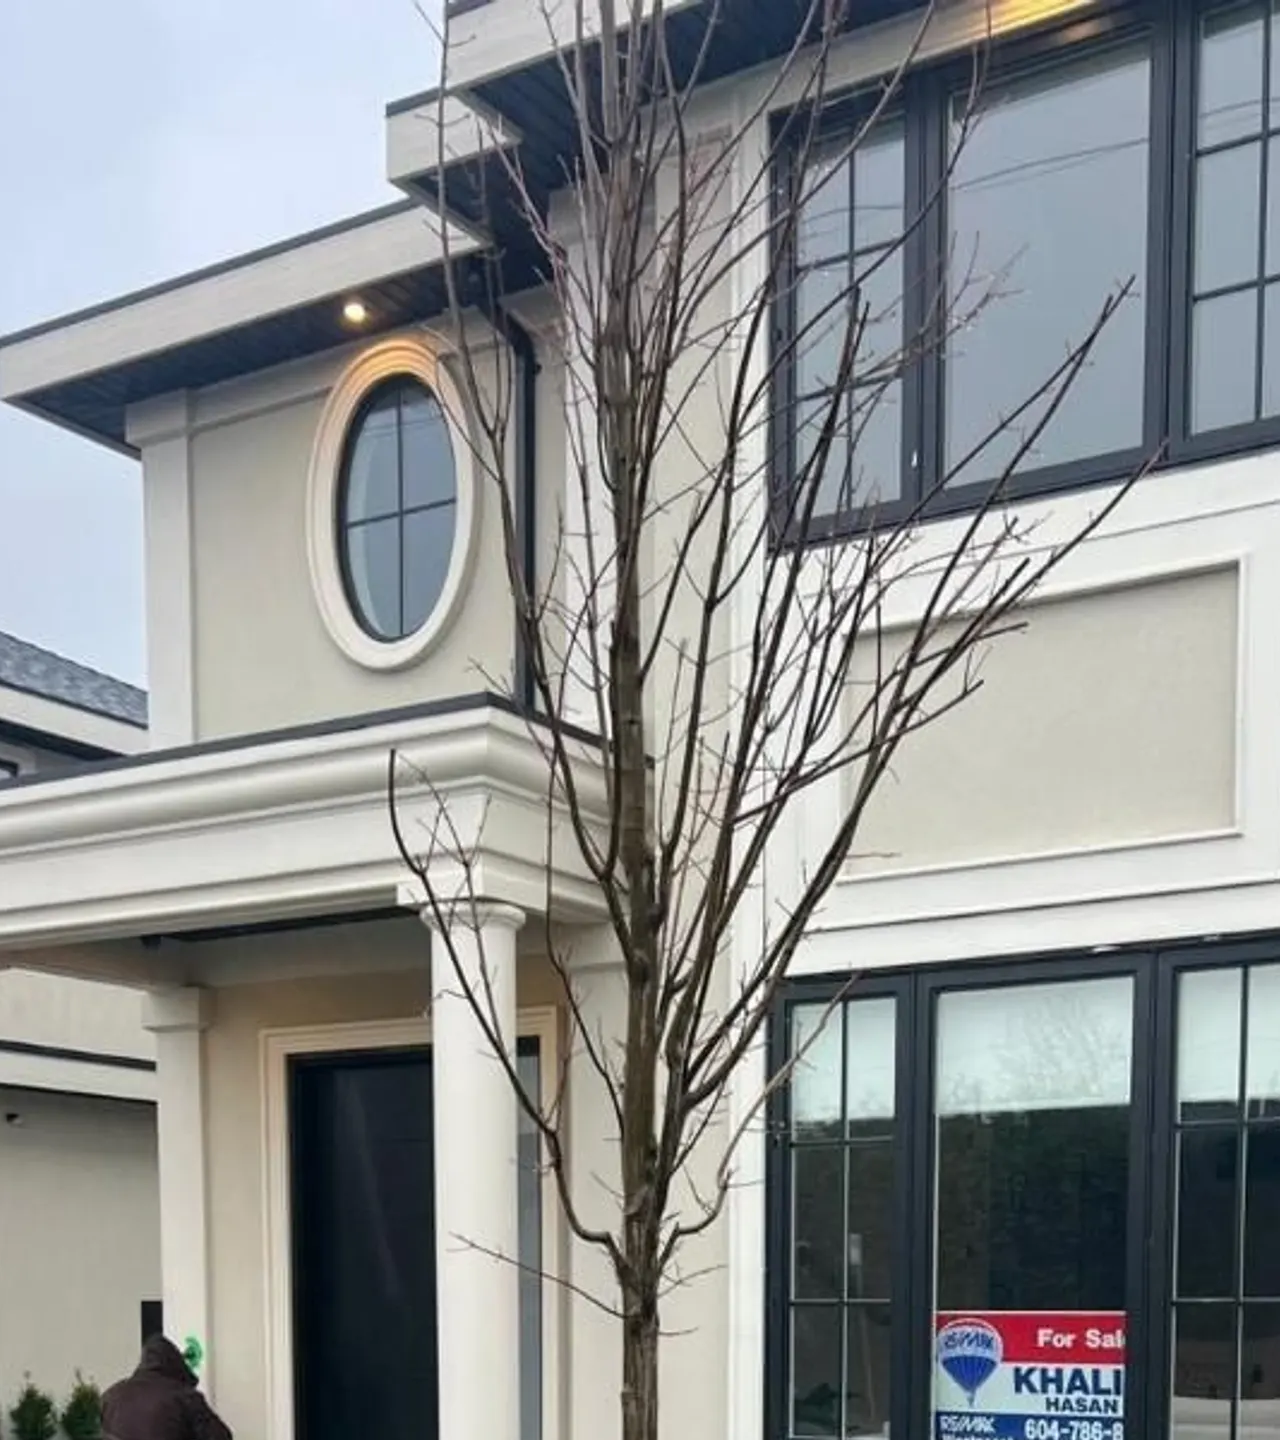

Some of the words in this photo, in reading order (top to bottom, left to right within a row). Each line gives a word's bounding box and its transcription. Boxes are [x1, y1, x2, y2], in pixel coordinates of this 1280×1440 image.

[1037, 1328, 1075, 1348] For
[1014, 1367, 1122, 1395] KHALI
[1045, 1397, 1119, 1414] HASAN
[939, 1415, 996, 1434] RE/MAX
